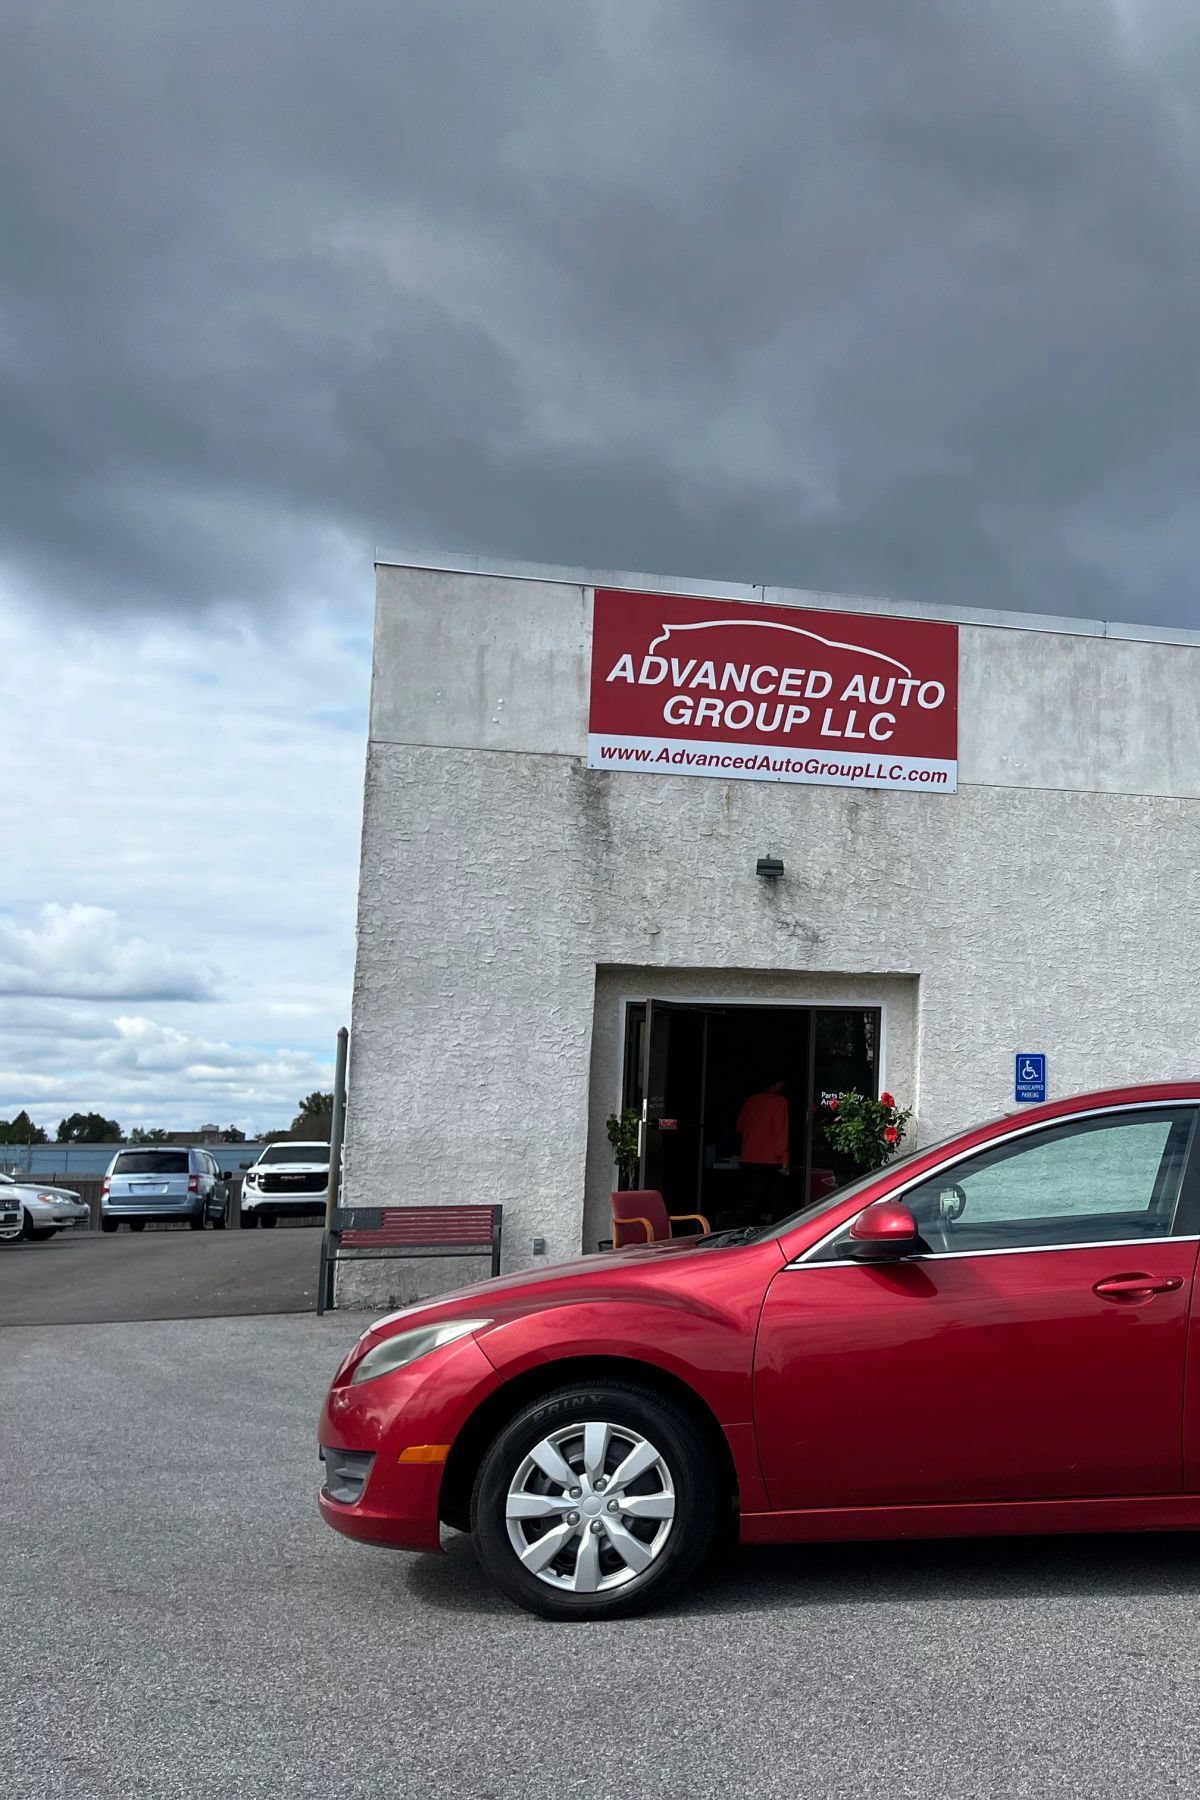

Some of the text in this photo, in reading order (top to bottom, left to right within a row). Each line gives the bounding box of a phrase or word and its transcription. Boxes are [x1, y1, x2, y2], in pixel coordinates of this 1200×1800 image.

[606, 653, 946, 709] ADVANCED AUTO
[662, 695, 897, 741] GROUP LLC
[600, 745, 948, 784] www.AdvancedAutoGroupLLC.com
